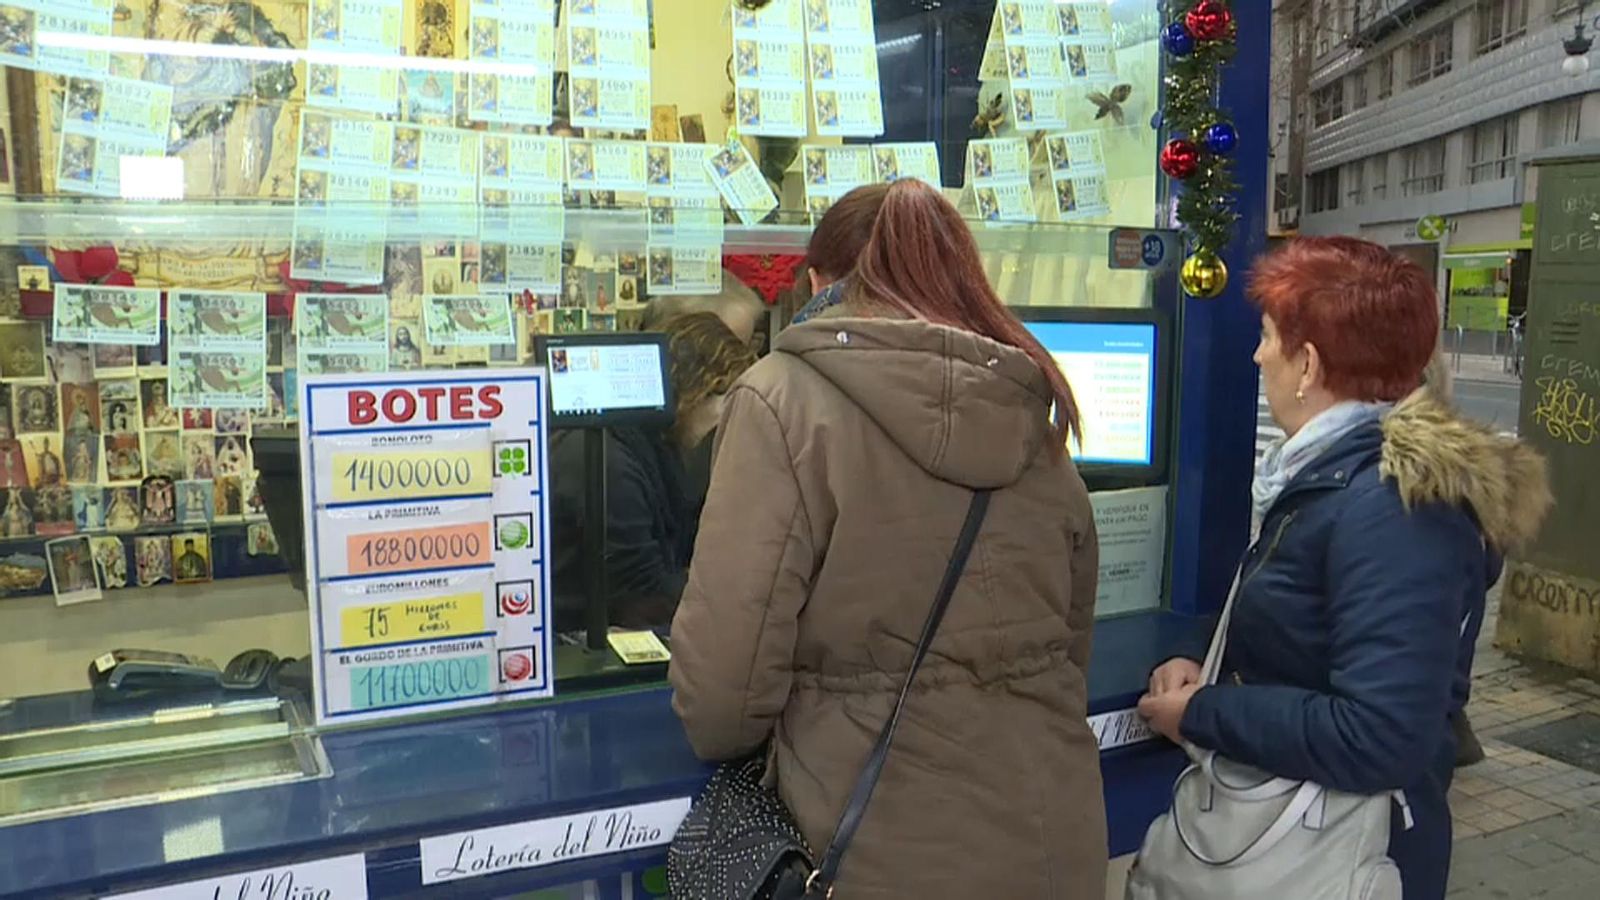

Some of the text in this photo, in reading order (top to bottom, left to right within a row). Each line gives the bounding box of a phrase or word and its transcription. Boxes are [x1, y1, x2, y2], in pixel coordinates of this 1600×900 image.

[348, 385, 504, 426] BOTES
[345, 457, 471, 492] 1400000
[368, 510, 383, 520] LA
[361, 532, 481, 568] 18800000
[362, 606, 392, 638] 75
[339, 655, 351, 665] EL
[397, 647, 412, 659] DE
[414, 646, 427, 657] LA
[429, 640, 484, 655] PRIMITIVA
[359, 658, 480, 706] 11700000
[435, 811, 661, 878] Lotería del Niño
